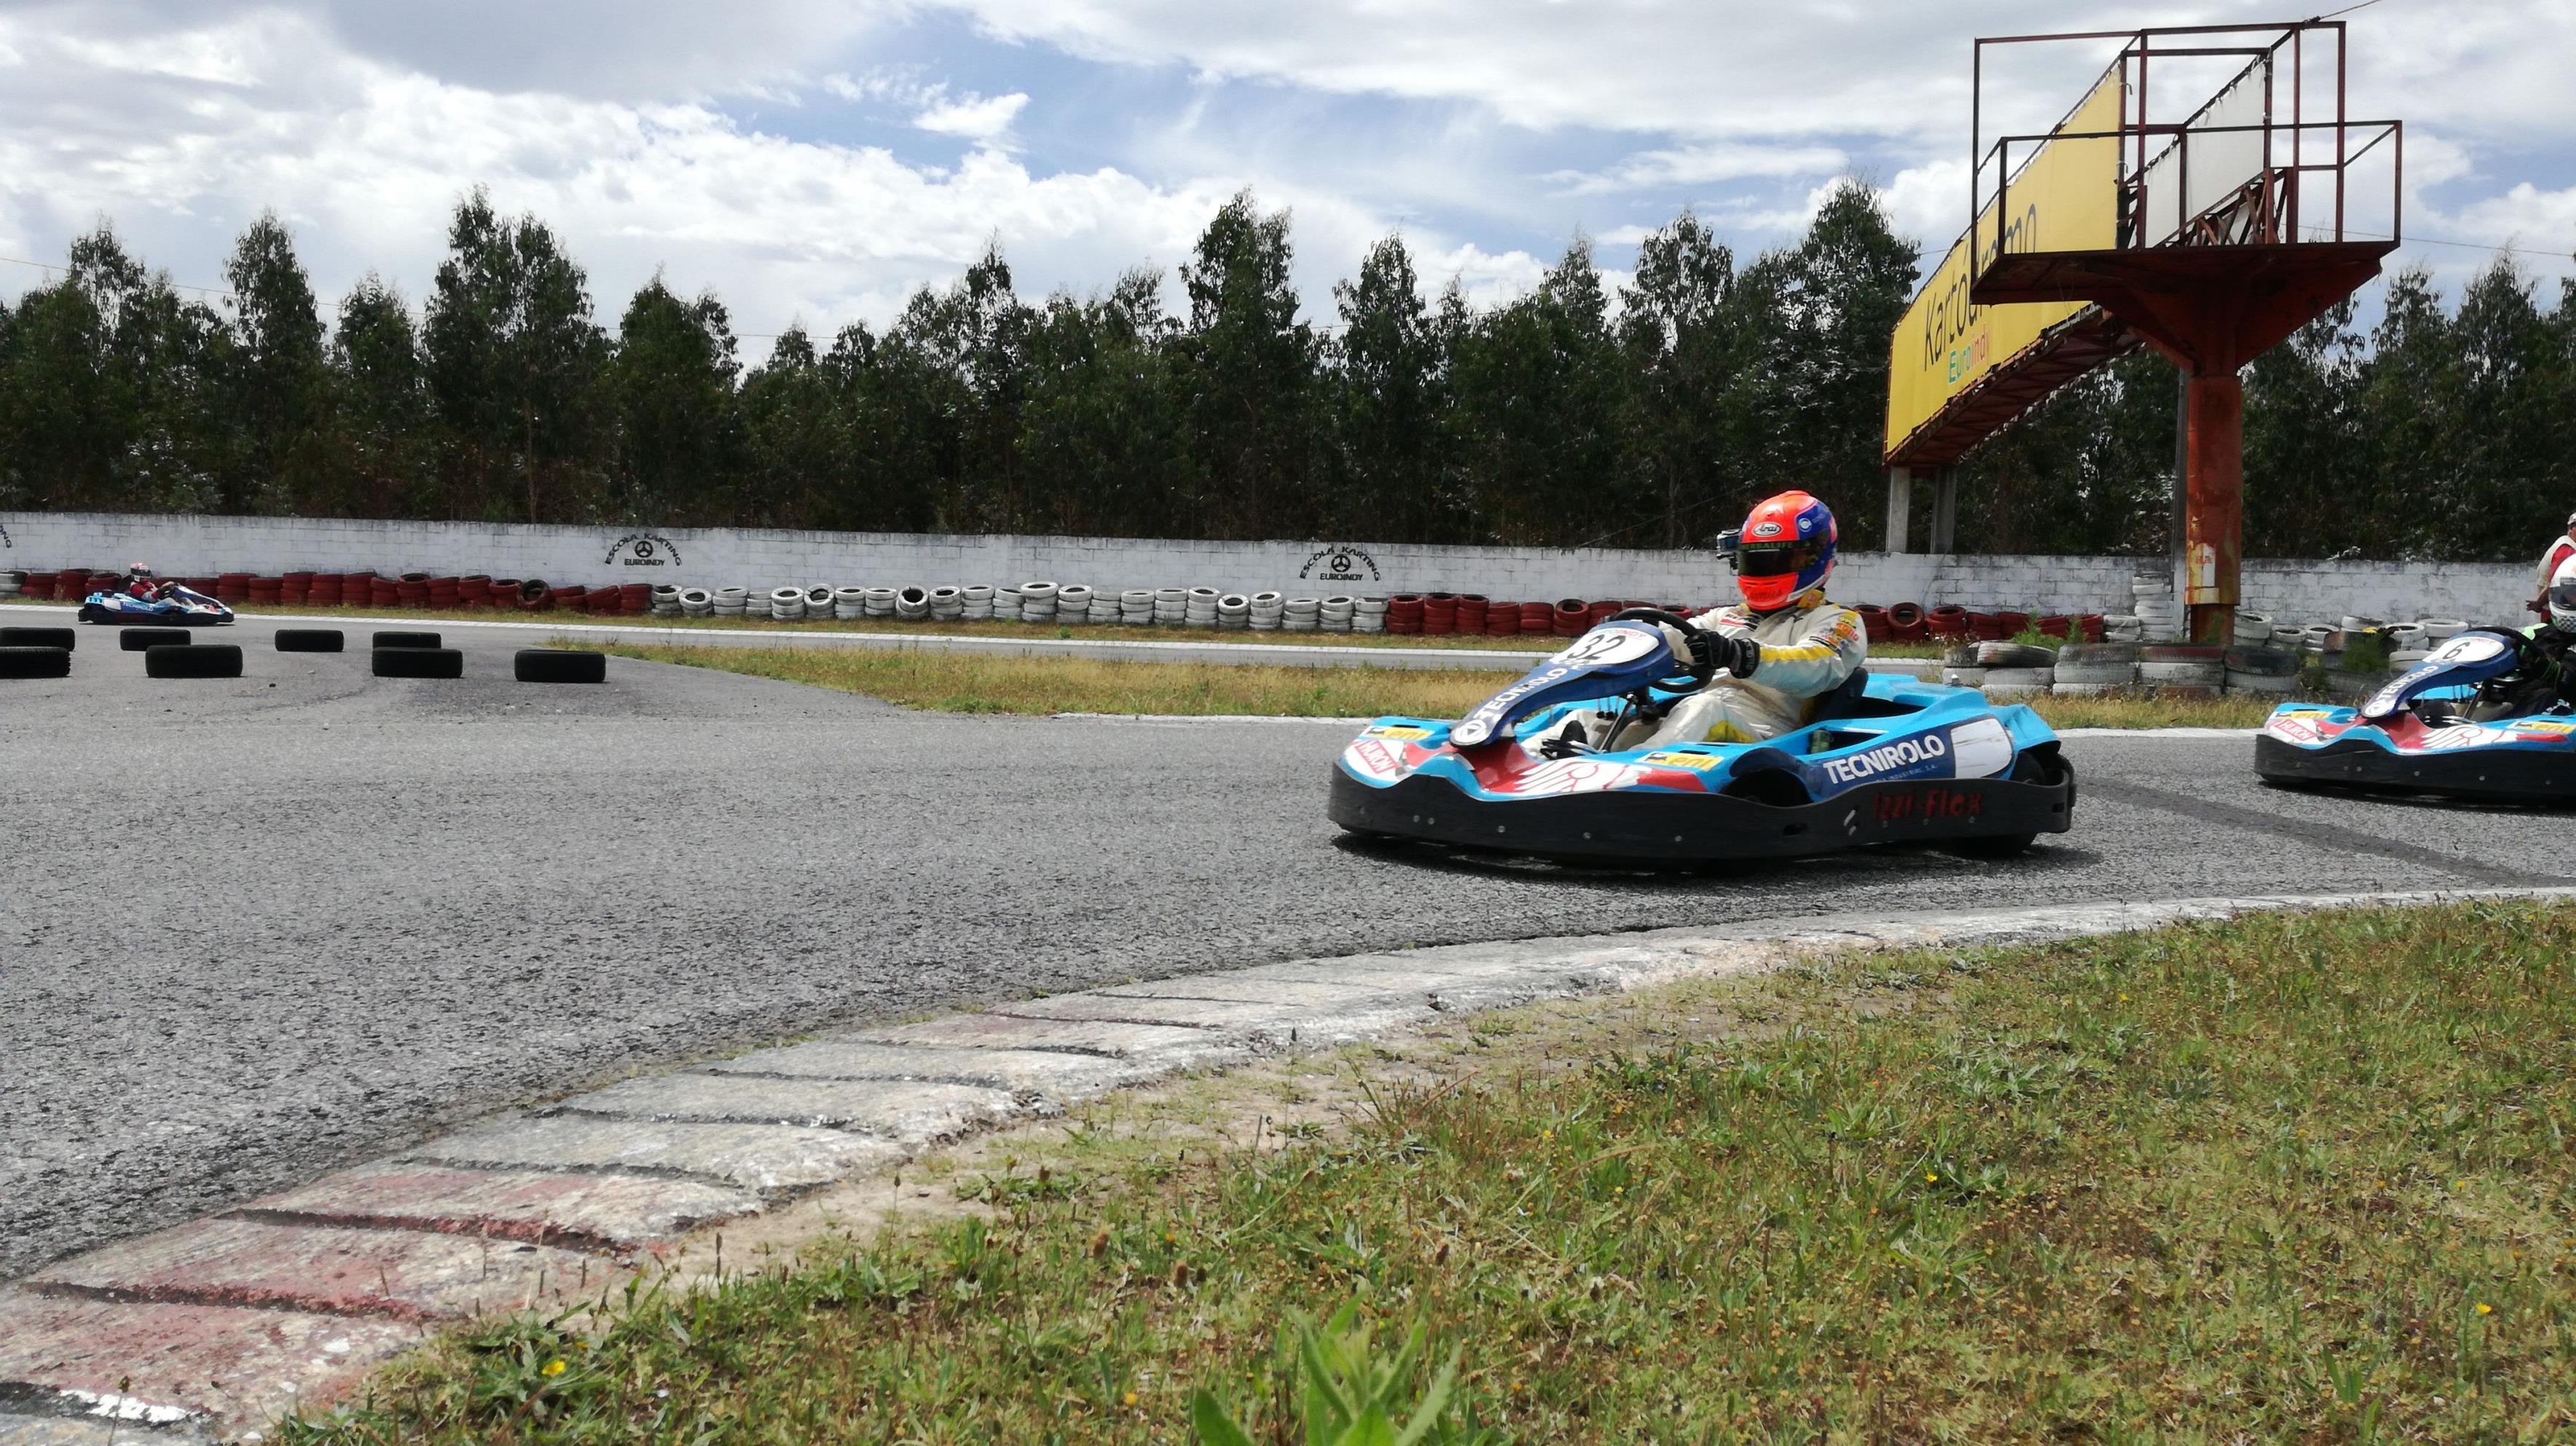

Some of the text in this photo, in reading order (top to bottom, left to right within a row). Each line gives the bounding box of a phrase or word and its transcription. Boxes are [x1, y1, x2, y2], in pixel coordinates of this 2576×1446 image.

[1754, 524, 1778, 533] Arai
[605, 533, 682, 566] ESCOLA KARTING
[1300, 546, 1381, 581] ESCOLA KARTING
[1319, 573, 1363, 581] EUROINDY
[1567, 634, 1626, 660] 32
[2443, 641, 2470, 659] 6
[1359, 741, 1394, 771] HURON
[1823, 735, 1945, 784] TECNIROLO
